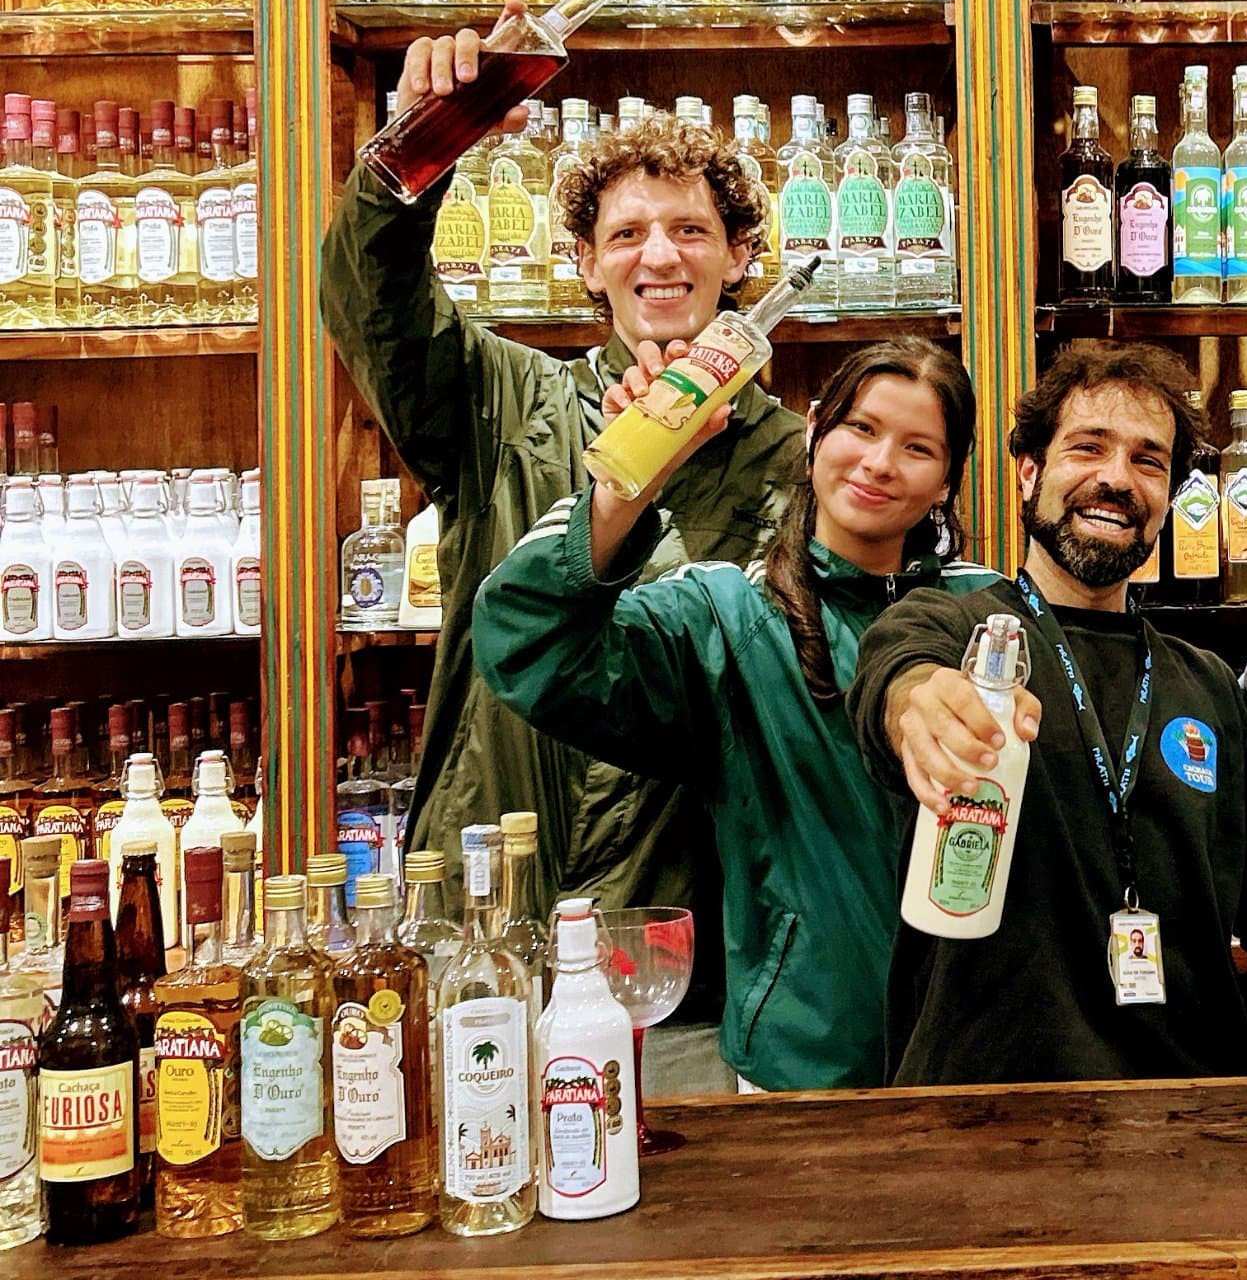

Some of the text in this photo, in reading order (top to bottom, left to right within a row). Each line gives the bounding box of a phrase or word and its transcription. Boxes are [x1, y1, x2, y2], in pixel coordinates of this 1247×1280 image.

[786, 193, 827, 205] MARIA
[842, 192, 882, 204] MARIA
[899, 193, 938, 205] MARIA
[784, 206, 830, 219] IZABEL
[840, 205, 885, 217] IZABEL
[897, 206, 942, 218] IZABEL
[438, 223, 479, 235] MARIA
[491, 219, 529, 231] ZABEL
[436, 236, 481, 248] IZABEL
[688, 347, 738, 379] RATIENSE
[1185, 772, 1214, 786] TOUR
[948, 807, 1001, 827] PARATIANA
[36, 821, 84, 834] PARATIANA
[338, 829, 377, 841] RATIANA
[949, 836, 990, 850] GABRIELA
[0, 1047, 36, 1069] TIANA
[166, 1065, 194, 1077] Ouro
[253, 1063, 303, 1082] Engenho
[336, 1066, 379, 1085] Engenho
[458, 1068, 514, 1083] COQUEIRO
[58, 1082, 100, 1093] Cachaça
[253, 1084, 303, 1100] D'Ouro
[338, 1086, 380, 1103] D'Ouro
[545, 1088, 598, 1103] PARATIANA
[43, 1090, 122, 1126] FURIOSA
